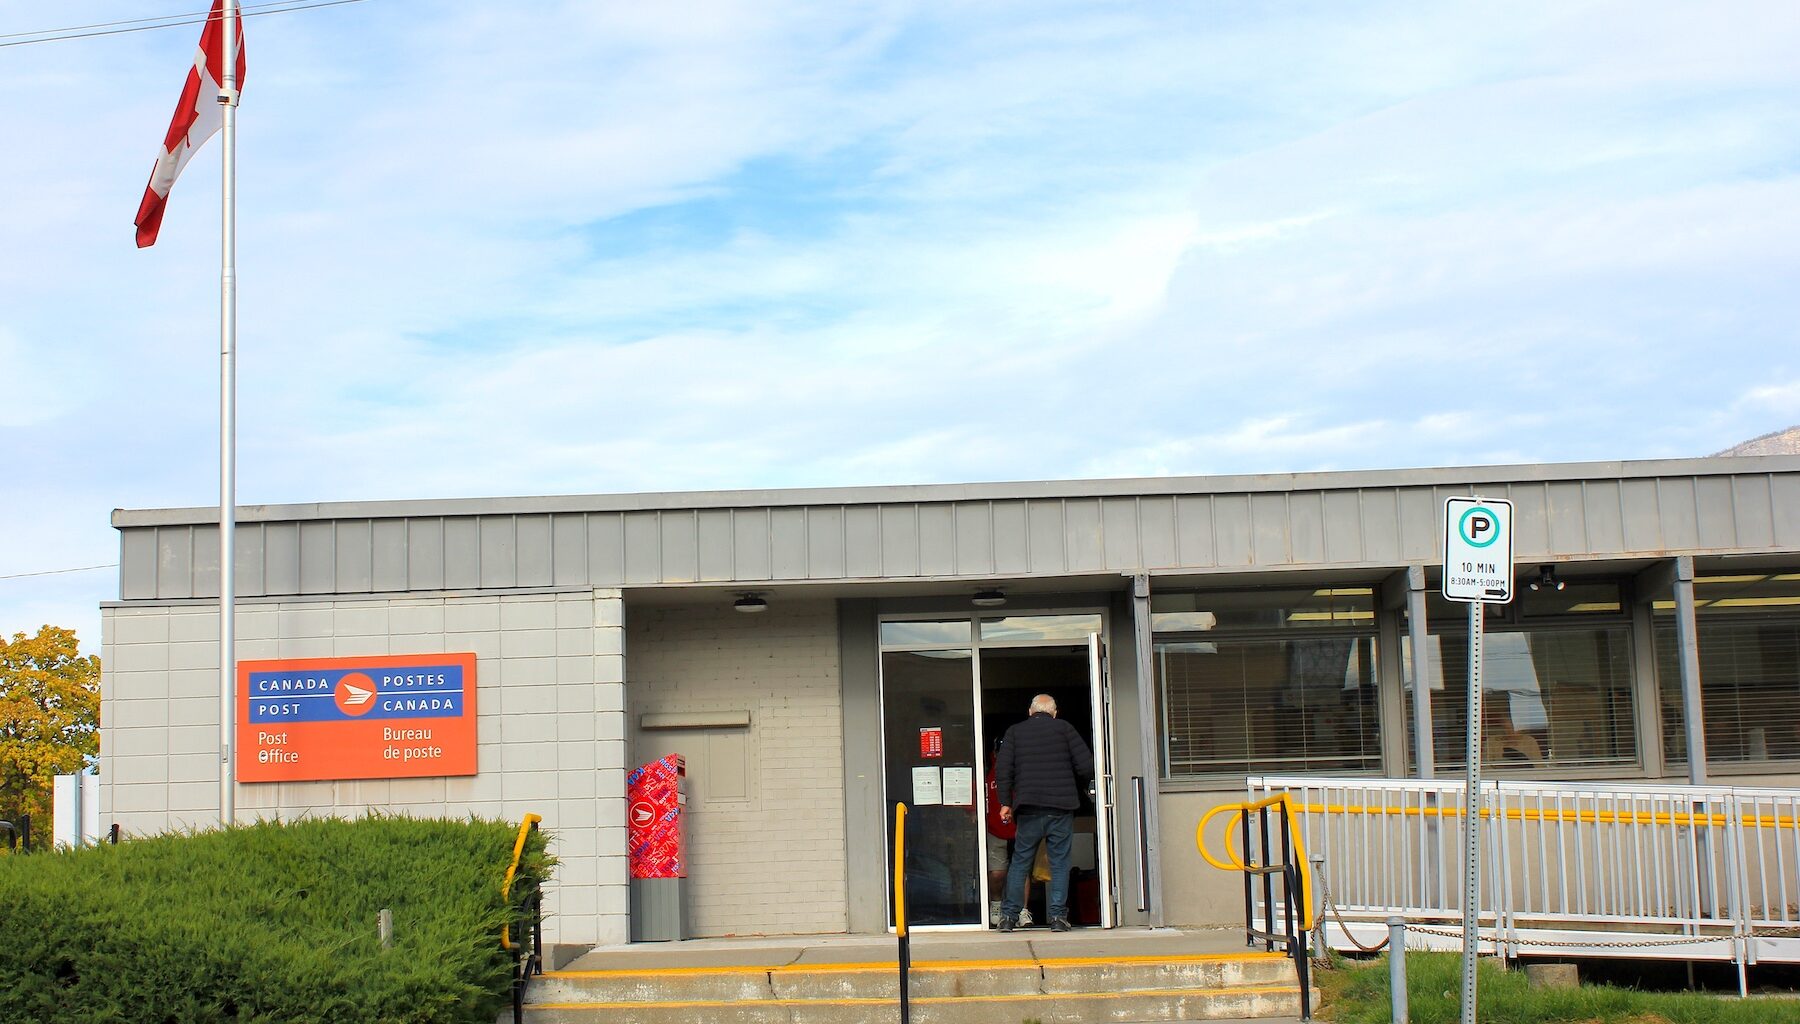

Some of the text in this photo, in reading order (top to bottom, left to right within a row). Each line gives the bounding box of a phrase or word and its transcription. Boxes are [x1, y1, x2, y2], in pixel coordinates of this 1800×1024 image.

[1471, 517, 1490, 538] P
[1462, 562, 1495, 573] 10 MIN
[1451, 578, 1505, 587] 8:30AM-5:00PM
[259, 678, 329, 691] CANADA
[383, 674, 445, 686] POSTES
[259, 703, 301, 715] POST
[383, 698, 453, 711] CANADA
[259, 731, 287, 744] Post
[384, 728, 432, 740] Bureau
[258, 749, 298, 763] Office
[384, 745, 441, 762] de poste
